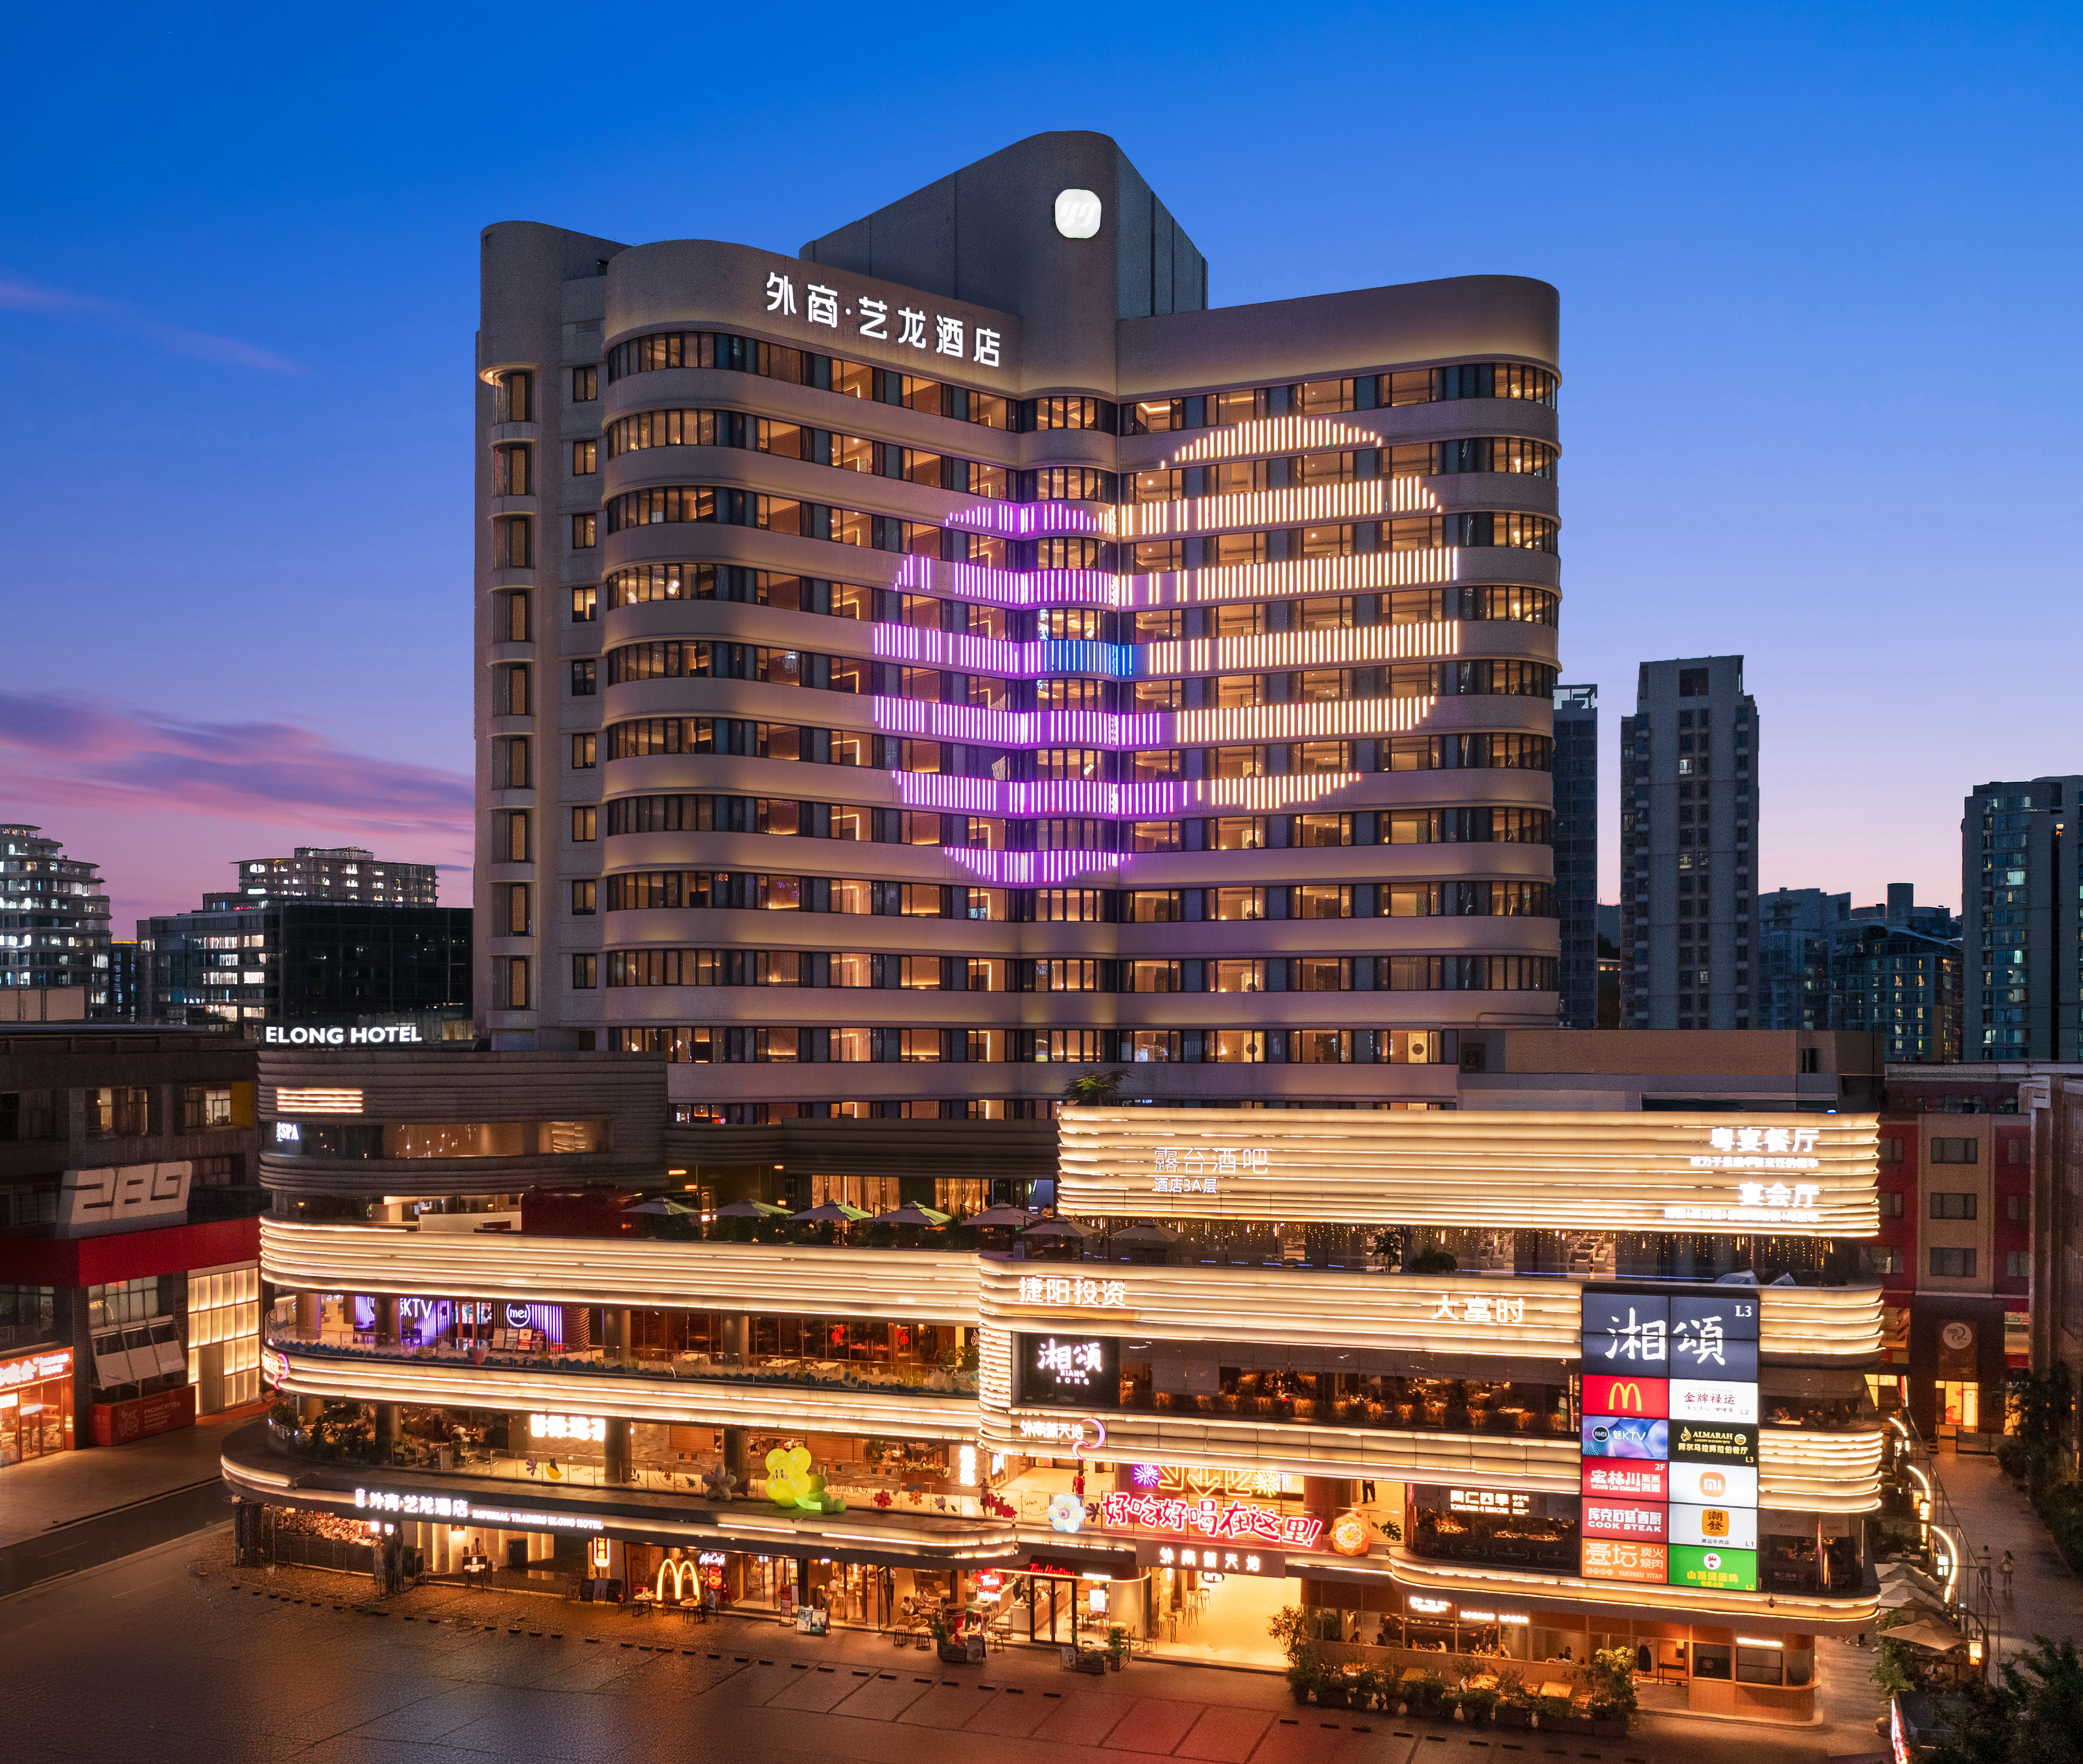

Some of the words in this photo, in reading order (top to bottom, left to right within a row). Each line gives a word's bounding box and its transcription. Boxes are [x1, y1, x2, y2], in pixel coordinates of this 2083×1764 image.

[767, 272, 1000, 367] 外商·艺龙酒店
[266, 1026, 344, 1044] ELONG
[350, 1025, 422, 1042] HOTEL
[1710, 1127, 1819, 1153] 粤宴餐厅
[1155, 1147, 1268, 1175] 露台酒吧
[1154, 1177, 1218, 1194] 酒店3A层
[1738, 1182, 1820, 1208] 宴会厅
[1019, 1276, 1126, 1307] 捷阳投资
[400, 1298, 433, 1320] KTV
[509, 1307, 528, 1319] mei
[1430, 1295, 1525, 1323] 大富时
[1735, 1305, 1752, 1317] L3
[1060, 1369, 1086, 1378] XIANG
[1683, 1392, 1735, 1405] 金牌禄运
[1613, 1430, 1646, 1441] 魅KTV
[1693, 1431, 1733, 1440] ALMARAH
[1678, 1443, 1748, 1455] 阿尔马拉阿拉伯餐厅
[1590, 1470, 1640, 1487] 宏林川
[1450, 1489, 1509, 1507] 同仁四季
[1450, 1503, 1466, 1511] TONG
[472, 1509, 510, 1522] IMPERIAL
[511, 1513, 547, 1524] TRADERS
[548, 1516, 575, 1527] ELONG
[576, 1519, 604, 1530] HOTEL
[1587, 1521, 1620, 1529] COOK
[1624, 1523, 1662, 1533] STEAK
[1586, 1542, 1638, 1568] 壹坛
[1640, 1547, 1664, 1558] 炭火
[1640, 1558, 1664, 1570] 烧肉
[981, 1574, 1000, 1586] Tims
